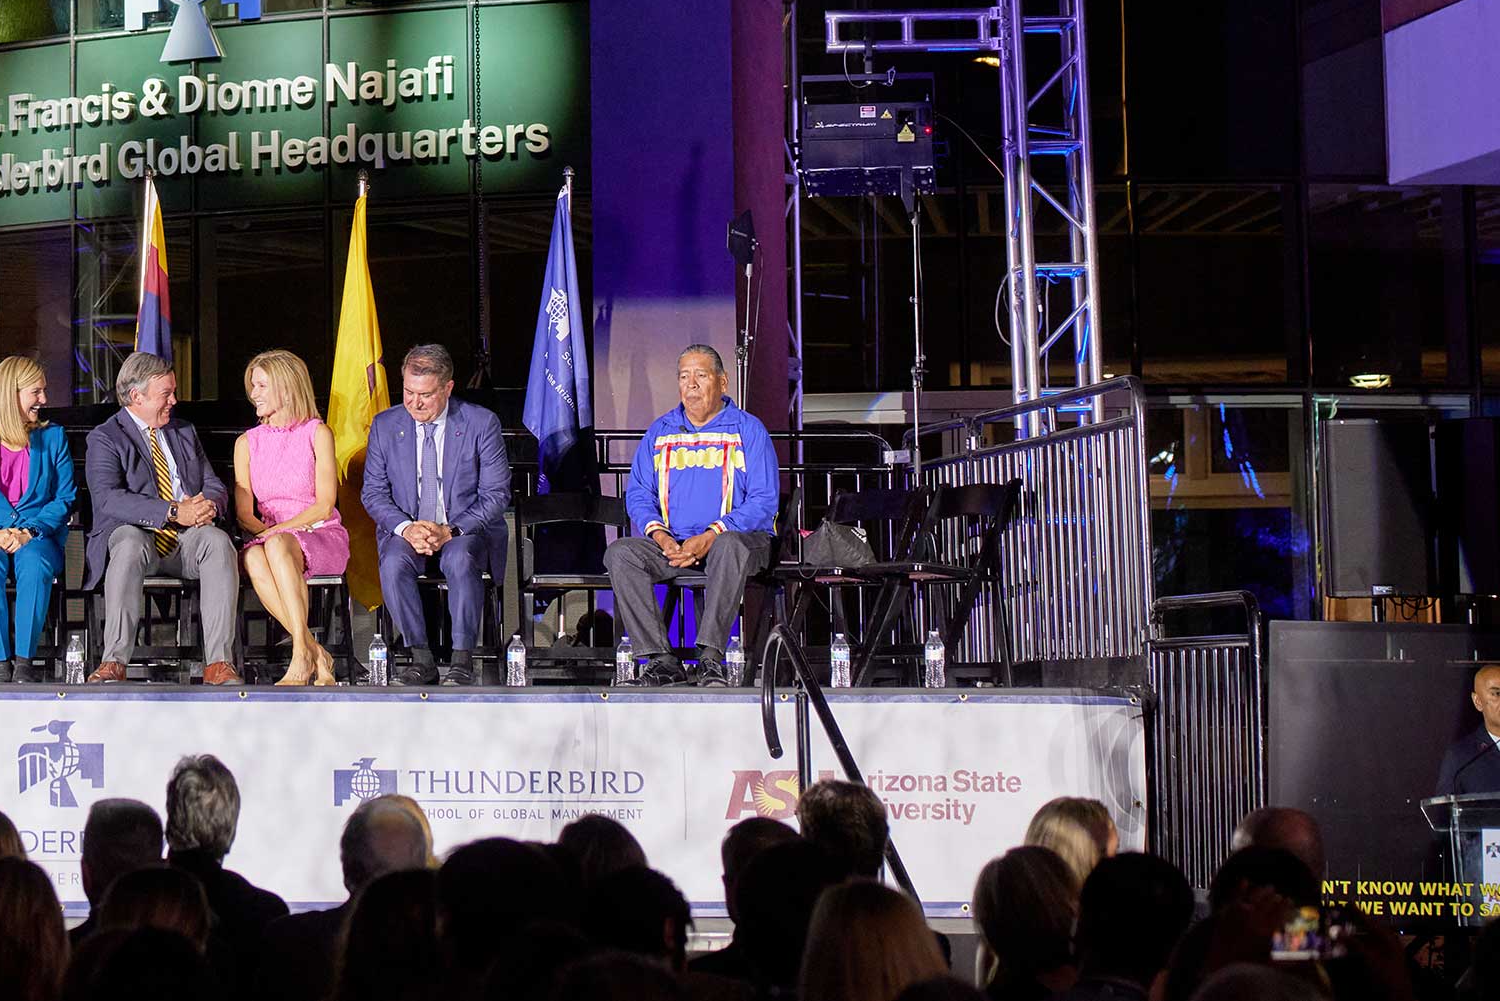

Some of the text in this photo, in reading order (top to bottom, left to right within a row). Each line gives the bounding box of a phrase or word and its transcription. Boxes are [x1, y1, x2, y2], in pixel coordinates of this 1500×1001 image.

[8, 82, 134, 130] Francis
[139, 78, 169, 117] &
[178, 73, 316, 113] Dionne
[325, 55, 454, 107] Najafi
[117, 134, 244, 180] Global
[250, 119, 550, 171] Headquarters
[409, 770, 645, 794] THUNDERBIRD
[867, 770, 1021, 793] rizona State
[725, 770, 835, 820] AS
[468, 808, 485, 820] OF
[493, 808, 544, 820] GLOBAL
[1321, 880, 1351, 895] N'T
[1357, 881, 1413, 896] KNOW
[1419, 882, 1474, 897] WHAT
[1356, 901, 1383, 915] WE
[1389, 902, 1444, 916] WANT
[1450, 902, 1474, 917] TO
